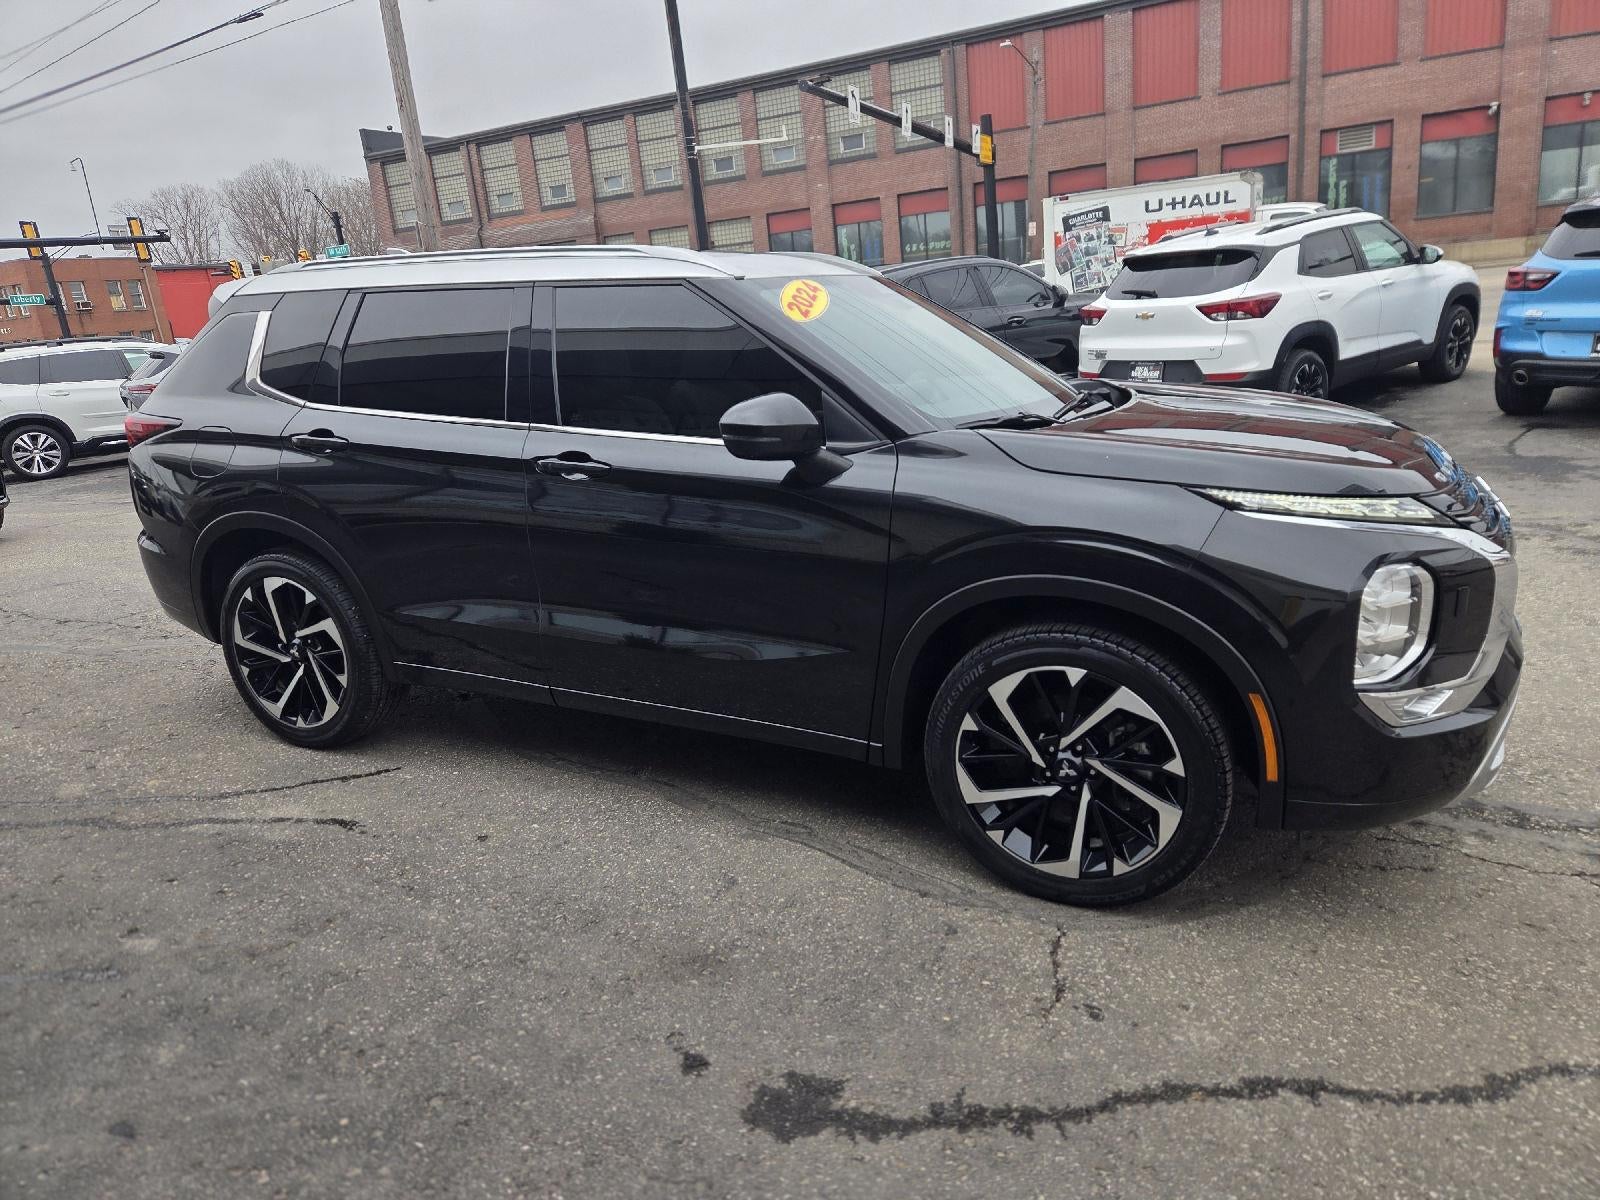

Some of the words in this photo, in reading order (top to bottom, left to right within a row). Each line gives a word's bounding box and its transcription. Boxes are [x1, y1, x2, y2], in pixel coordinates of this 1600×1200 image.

[1144, 190, 1237, 213] U-HAUL
[1068, 211, 1104, 225] CHARLOTTE
[13, 295, 41, 304] Liberty
[787, 280, 822, 319] 2024
